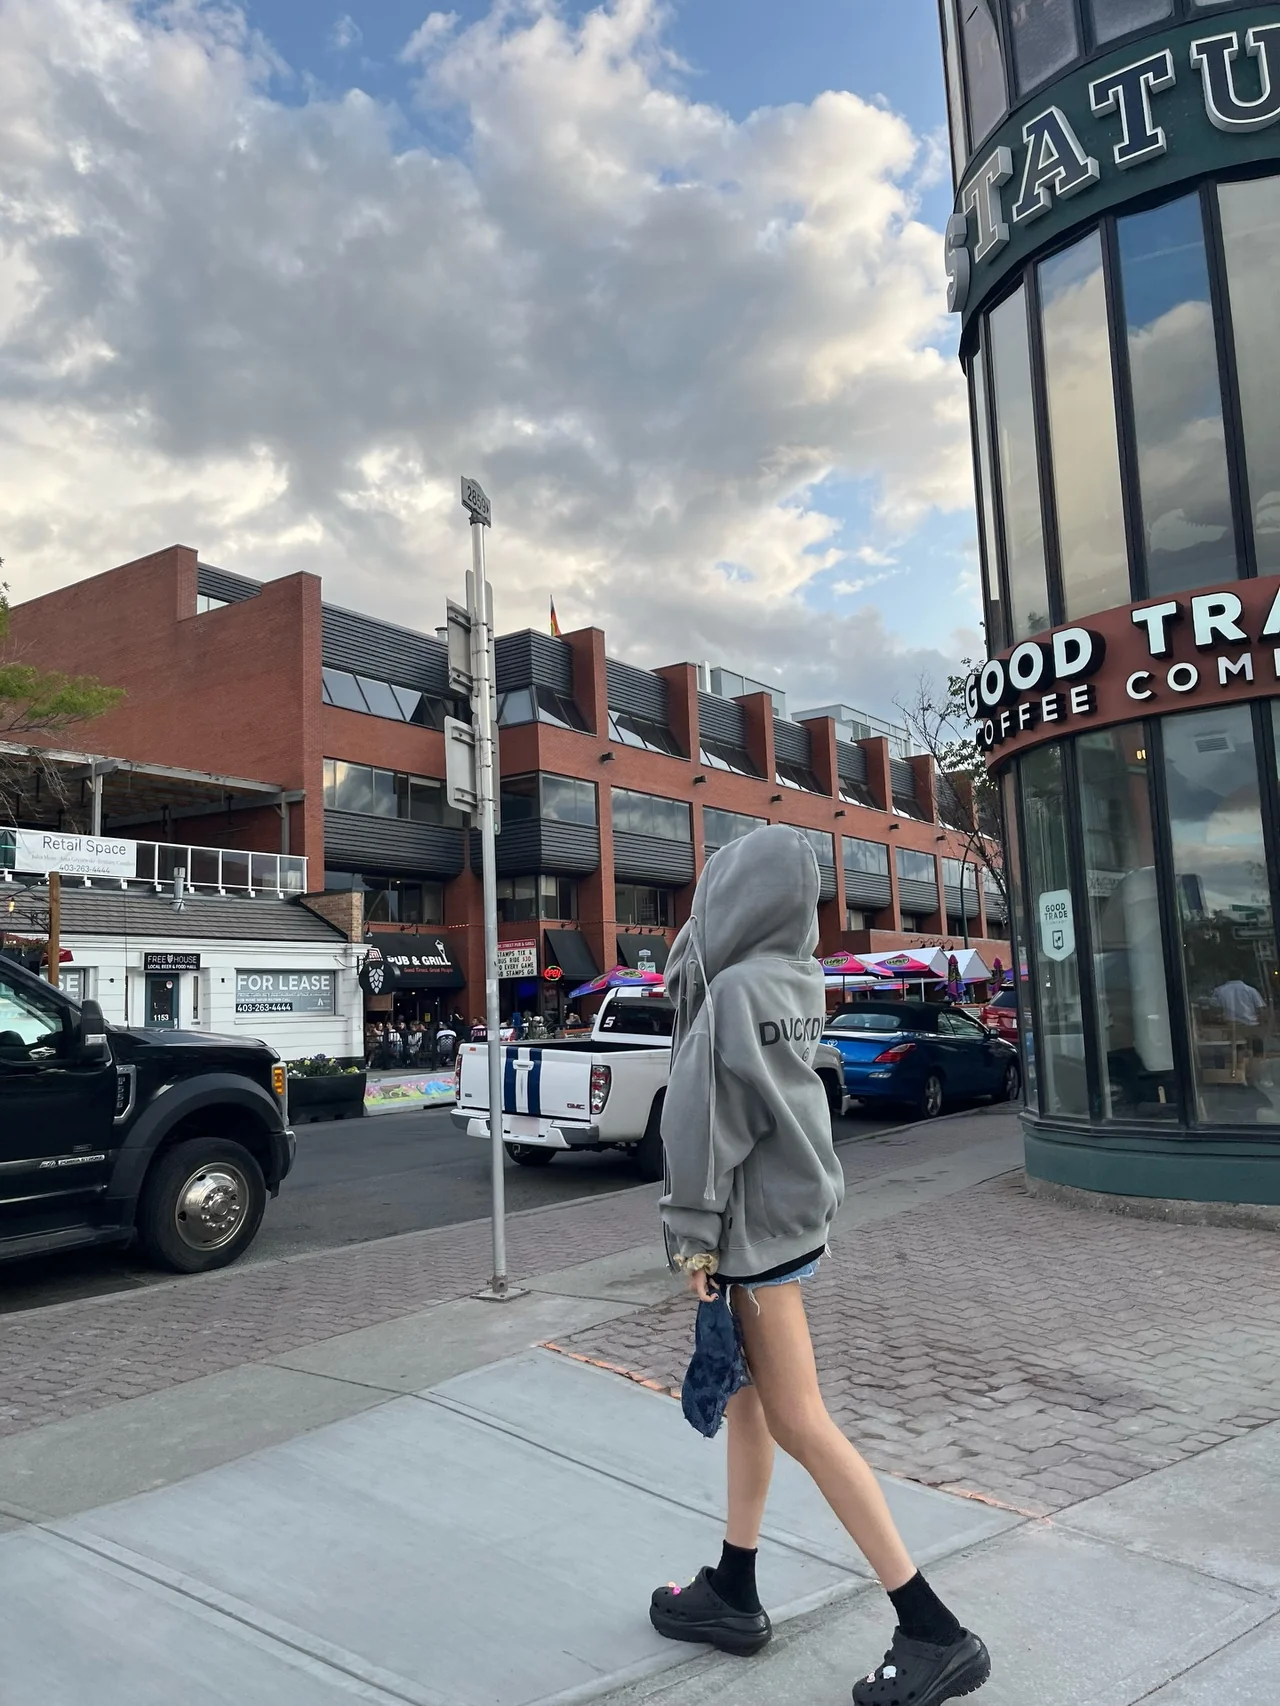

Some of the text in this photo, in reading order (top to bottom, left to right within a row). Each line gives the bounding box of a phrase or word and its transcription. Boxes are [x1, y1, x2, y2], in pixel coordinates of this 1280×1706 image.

[965, 586, 1280, 719] GOOD TR
[1126, 648, 1280, 701] COM
[42, 835, 127, 856] Retail Space
[59, 863, 111, 874] 403-263-4444
[1045, 902, 1066, 913] GOOD
[1044, 910, 1068, 920] TRADE
[147, 955, 197, 964] FREE HOUSE
[411, 955, 421, 966] &
[422, 955, 452, 966] GRILL
[506, 969, 525, 977] STAMPS
[546, 969, 560, 977] OPEN
[237, 975, 330, 991] FOR LEASE
[237, 1003, 291, 1012] 403-263-4444
[759, 1016, 824, 1047] DUCKD
